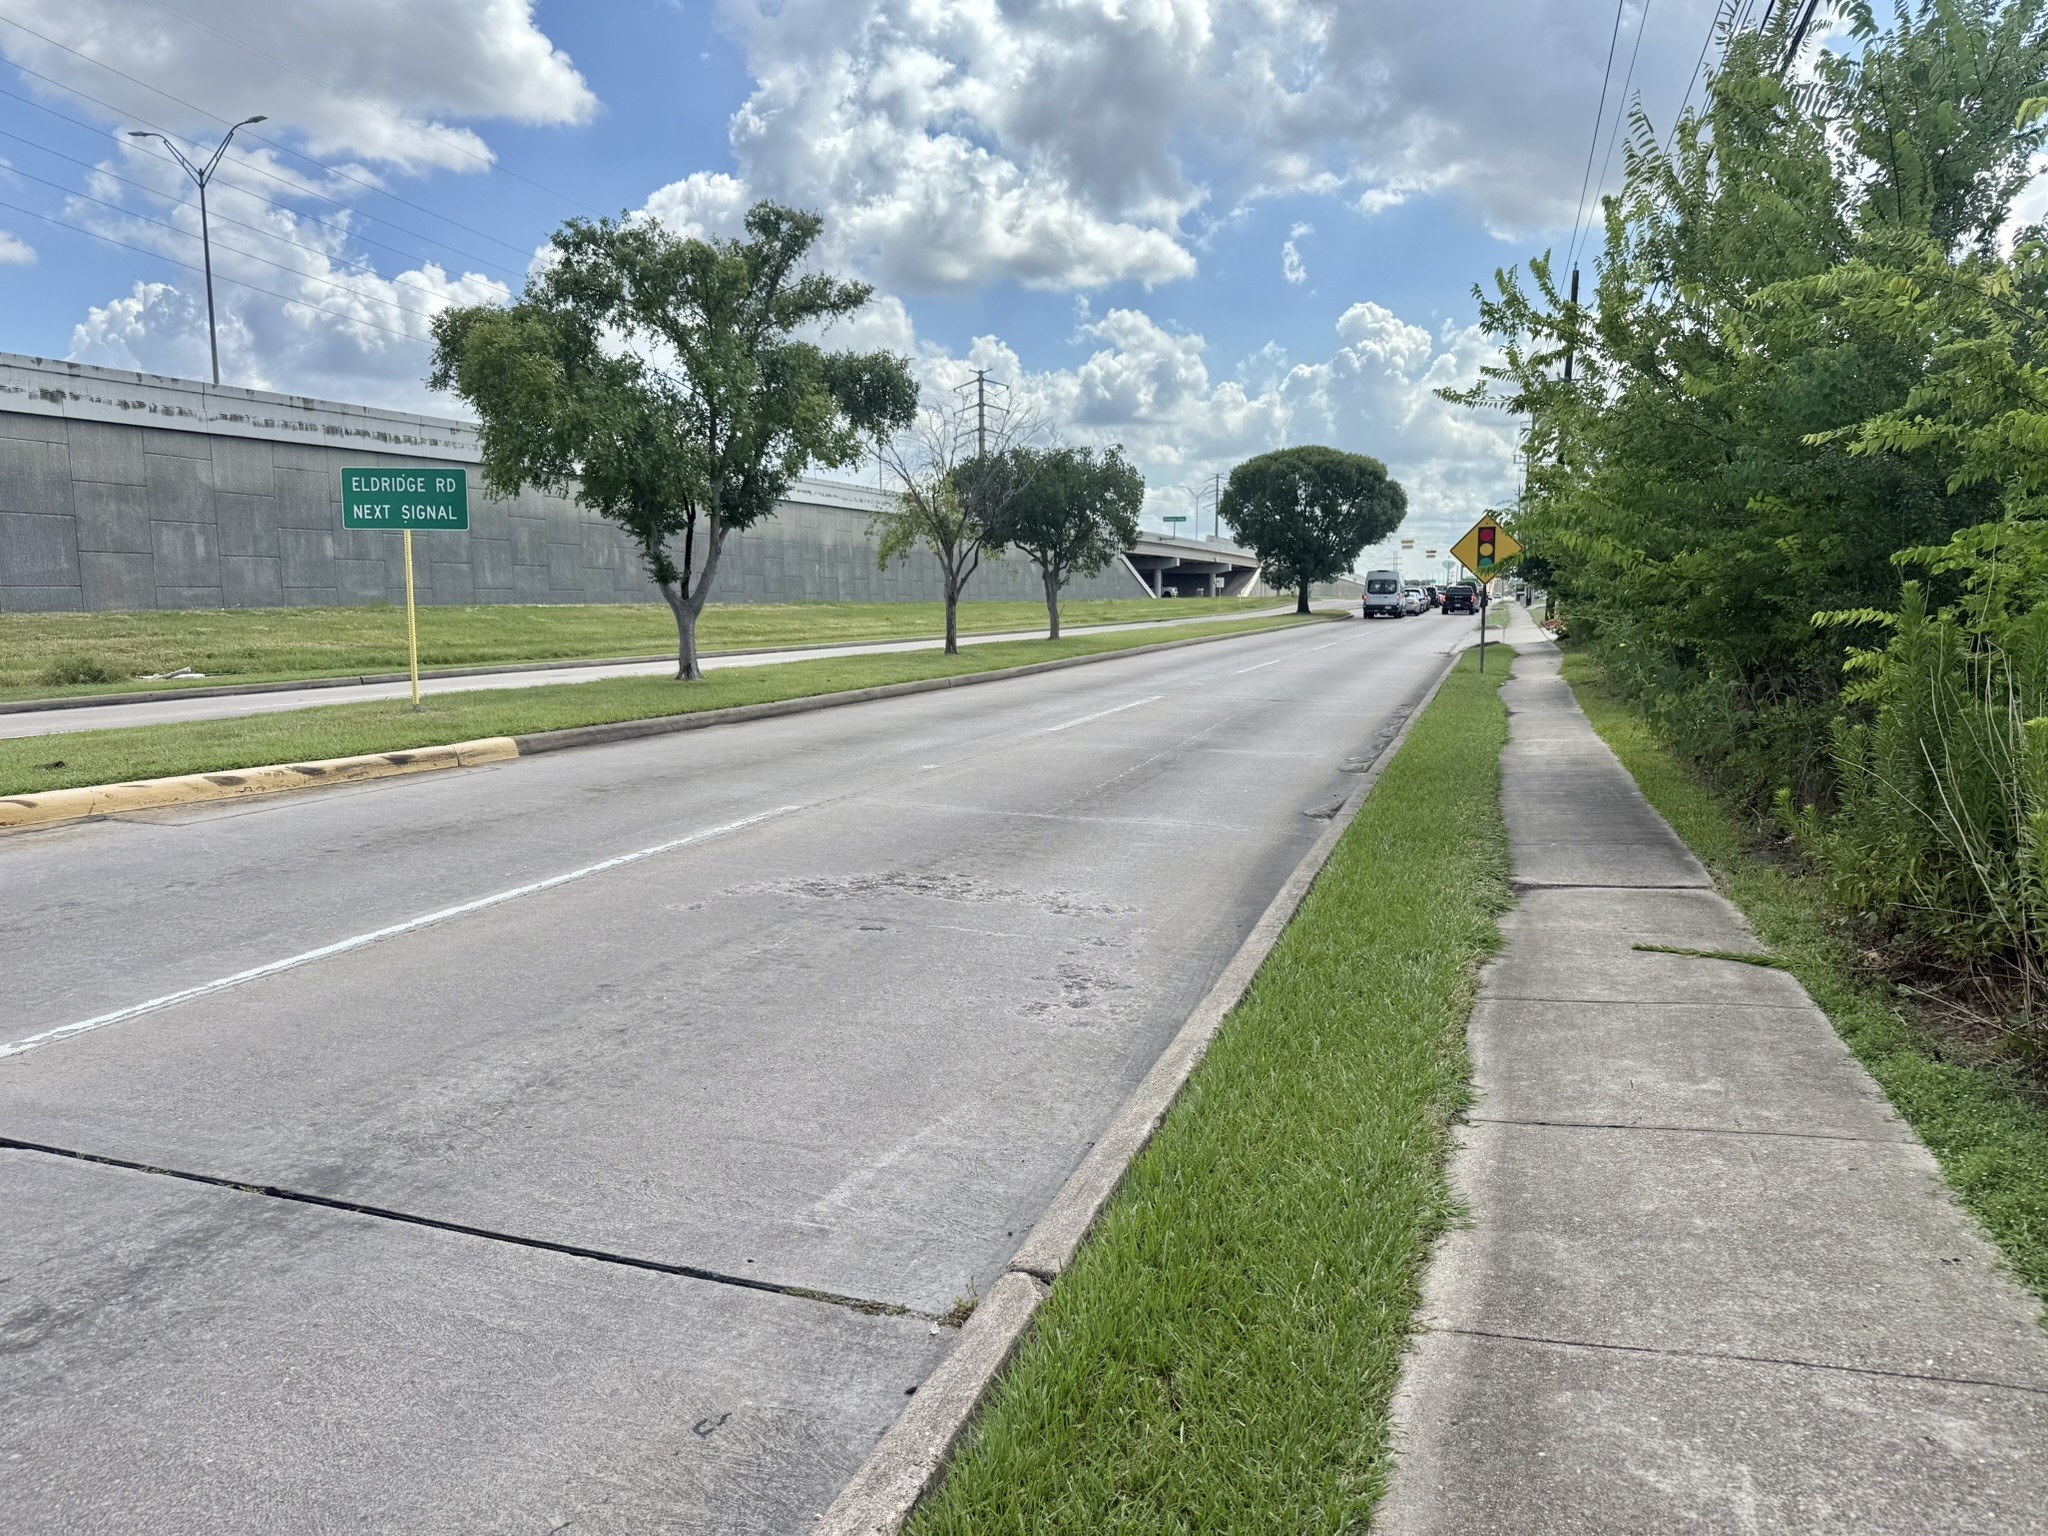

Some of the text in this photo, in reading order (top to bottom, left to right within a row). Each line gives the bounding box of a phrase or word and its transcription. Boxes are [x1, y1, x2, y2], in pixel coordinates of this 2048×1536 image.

[352, 477, 456, 492] ELDRIDGE RD
[353, 504, 457, 520] NEXT SIGNAL
